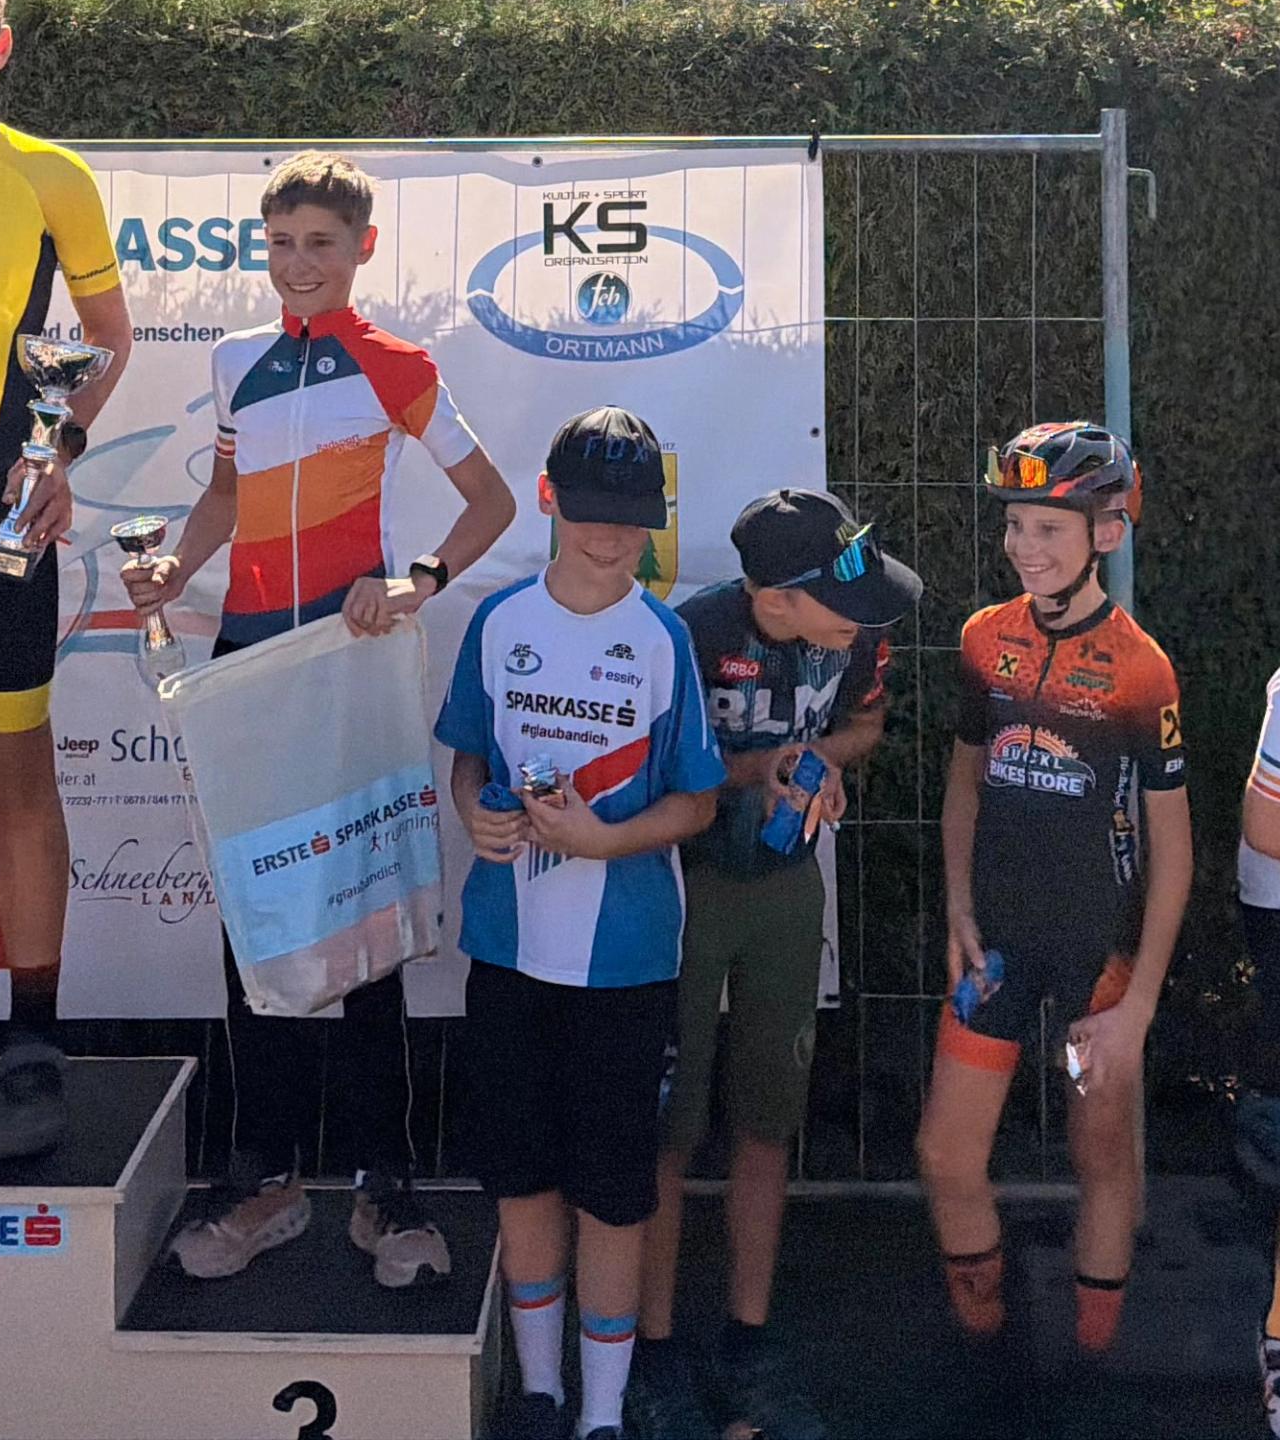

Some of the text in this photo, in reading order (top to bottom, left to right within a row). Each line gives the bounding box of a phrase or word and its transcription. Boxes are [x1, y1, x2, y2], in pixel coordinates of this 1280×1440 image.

[542, 191, 590, 201] KULTUR
[603, 190, 647, 200] SPORT
[543, 200, 648, 256] KS
[114, 216, 271, 273] ASSE
[543, 255, 648, 268] ORGANISATION
[132, 322, 225, 342] enschen
[545, 333, 665, 359] ORTMANN
[605, 669, 644, 689] essity
[506, 690, 615, 724] SPARKASSE
[57, 735, 100, 754] Jeep
[521, 722, 609, 747] #glaubandich
[251, 791, 419, 877] ERSTE SPARKASSE
[69, 838, 213, 923] Schneeberg
